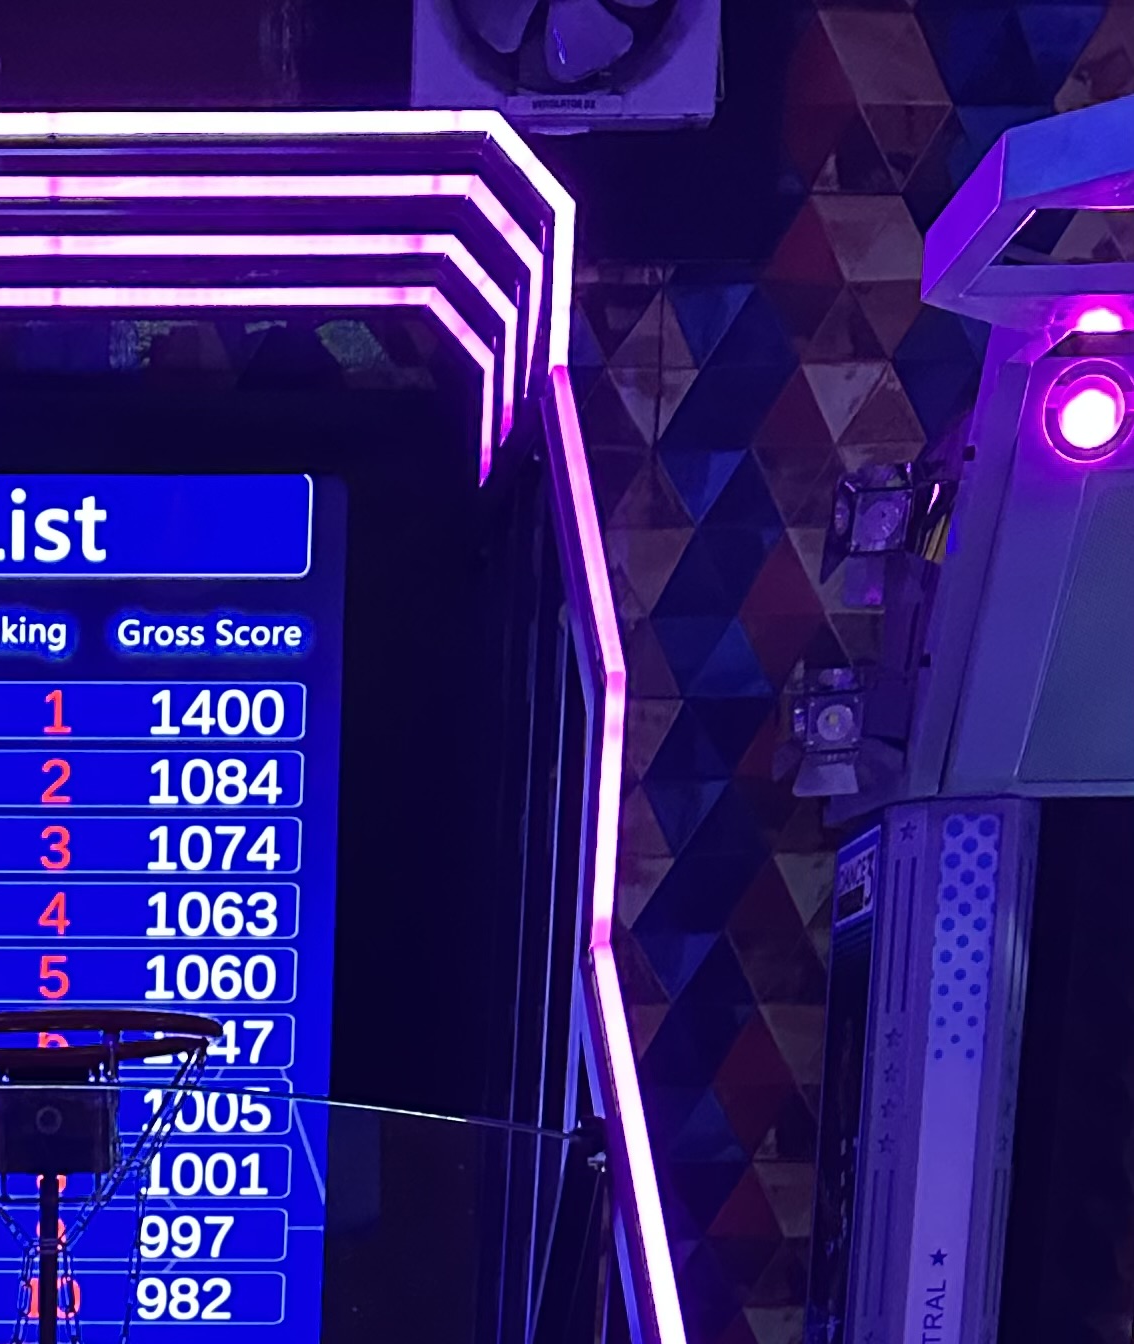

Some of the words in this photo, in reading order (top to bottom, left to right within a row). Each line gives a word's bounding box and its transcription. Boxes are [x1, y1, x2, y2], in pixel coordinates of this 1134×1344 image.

[116, 618, 205, 647] Gross
[215, 618, 303, 647] Score
[42, 689, 72, 734] 1
[148, 688, 285, 736] 1400
[40, 759, 71, 805] 2
[147, 758, 283, 806] 1084
[39, 825, 71, 871] 3
[146, 825, 281, 871] 1074
[38, 891, 70, 935] 4
[144, 891, 279, 938] 1063
[38, 955, 69, 1000] 5
[144, 953, 277, 1001] 1060
[142, 1086, 272, 1133] 1005
[140, 1152, 269, 1197] 1001
[138, 1215, 235, 1259] 997
[136, 1276, 233, 1320] 982
